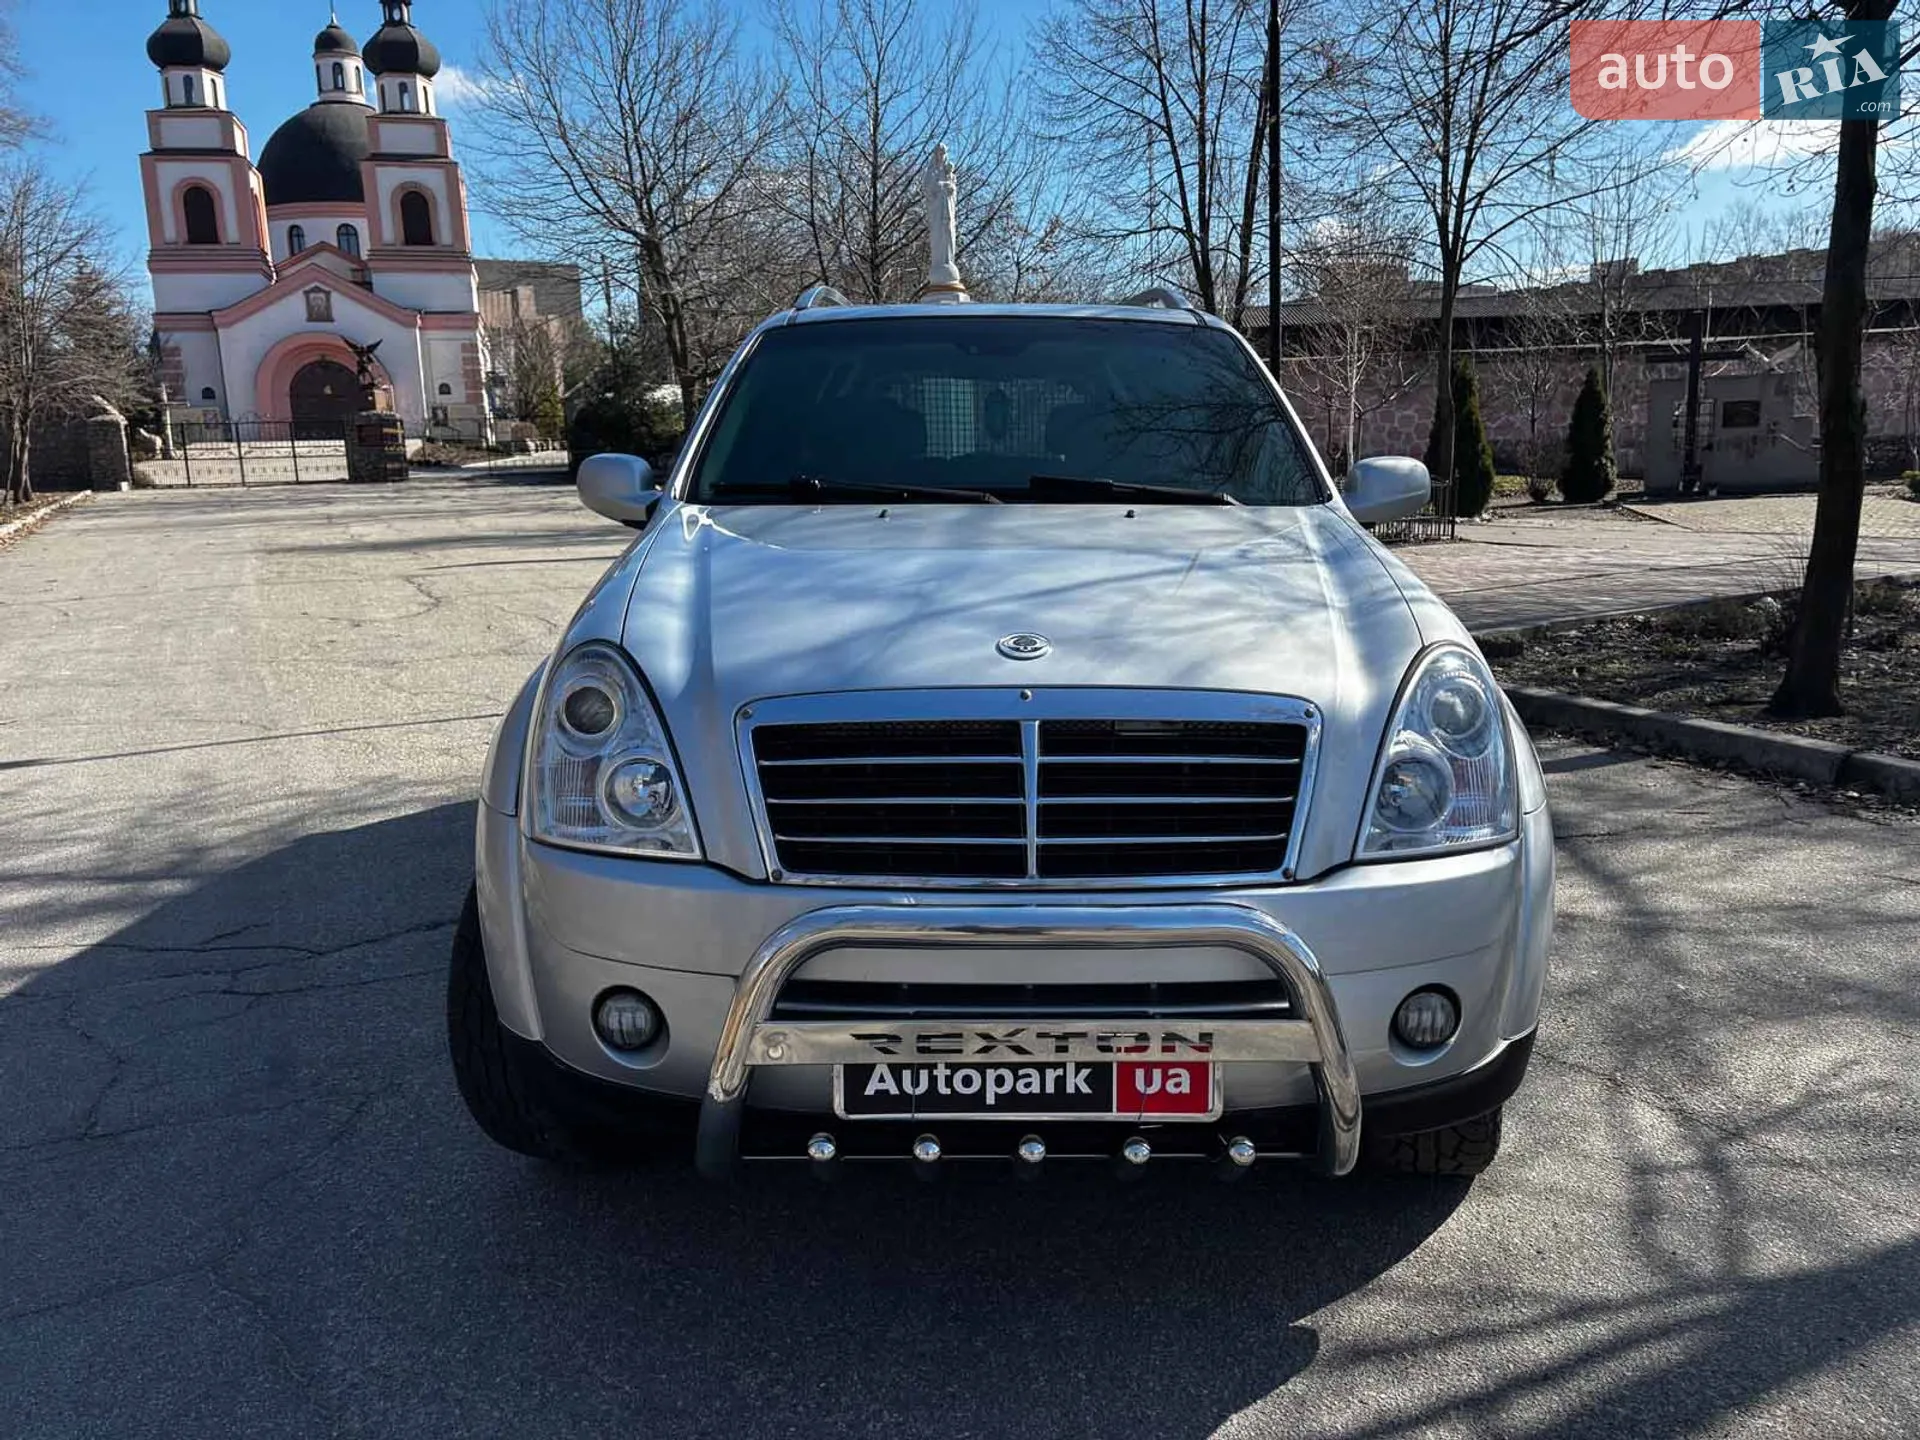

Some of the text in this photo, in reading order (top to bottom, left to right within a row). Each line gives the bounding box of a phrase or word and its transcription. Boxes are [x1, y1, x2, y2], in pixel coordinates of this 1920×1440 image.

[850, 1028, 1214, 1055] REXTON
[864, 1063, 1191, 1104] Autopark ua
